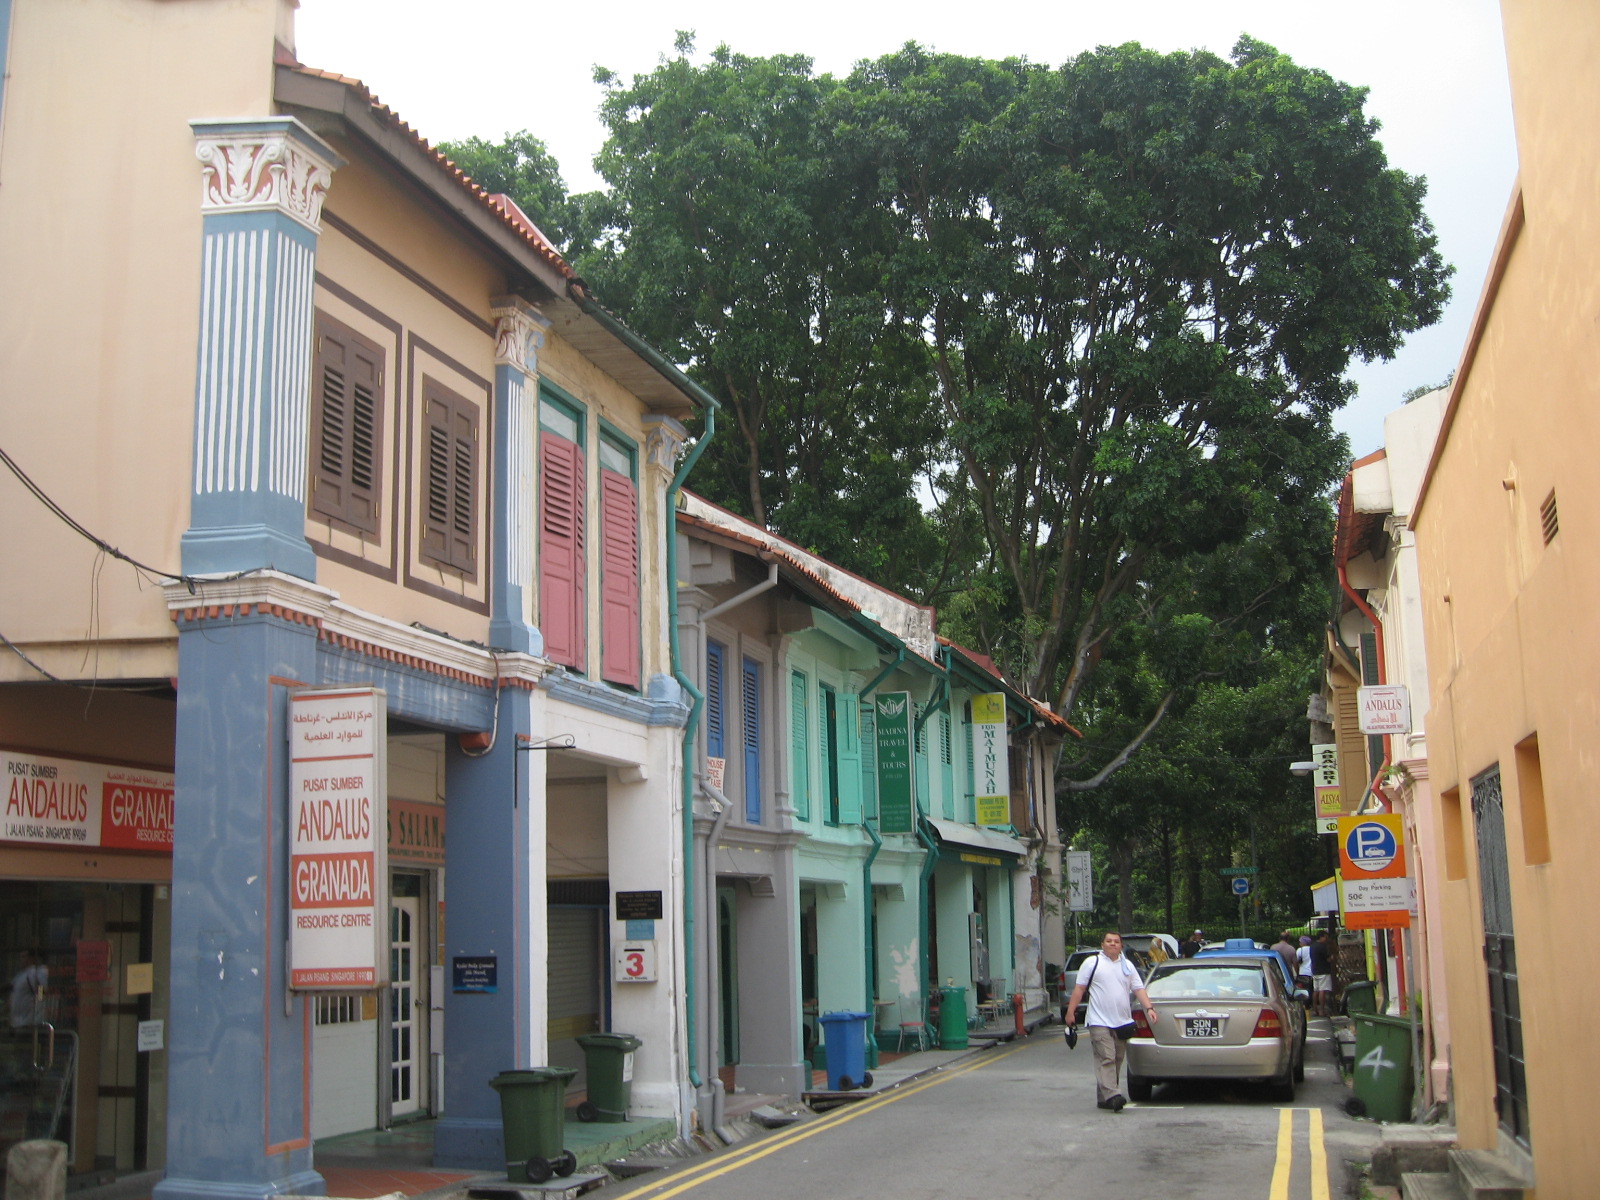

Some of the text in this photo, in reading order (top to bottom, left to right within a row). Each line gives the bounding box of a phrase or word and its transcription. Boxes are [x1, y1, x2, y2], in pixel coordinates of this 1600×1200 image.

[1365, 699, 1402, 711] ANDALUS
[878, 728, 907, 736] MADINA
[879, 739, 907, 748] TRAVEL
[8, 761, 58, 779] PUSAT SUMBER
[882, 761, 907, 770] TOURS
[303, 777, 363, 792] PUSAT SUMBER
[6, 777, 88, 822] ANDALUS
[297, 797, 370, 843] ANDALUS
[10, 824, 26, 837] JALAN
[45, 827, 71, 841] SINGAPORE
[136, 828, 166, 843] RESOURCE
[400, 811, 439, 848] SALAM
[1356, 826, 1385, 858] P
[296, 858, 371, 903] GRANADA
[297, 914, 371, 929] RESOURCE CENTRE
[626, 952, 644, 977] 3
[300, 972, 313, 982] JALAN
[331, 971, 355, 982] SINGAPORE
[1193, 1020, 1211, 1028] SDN
[1359, 1045, 1396, 1080] 4
